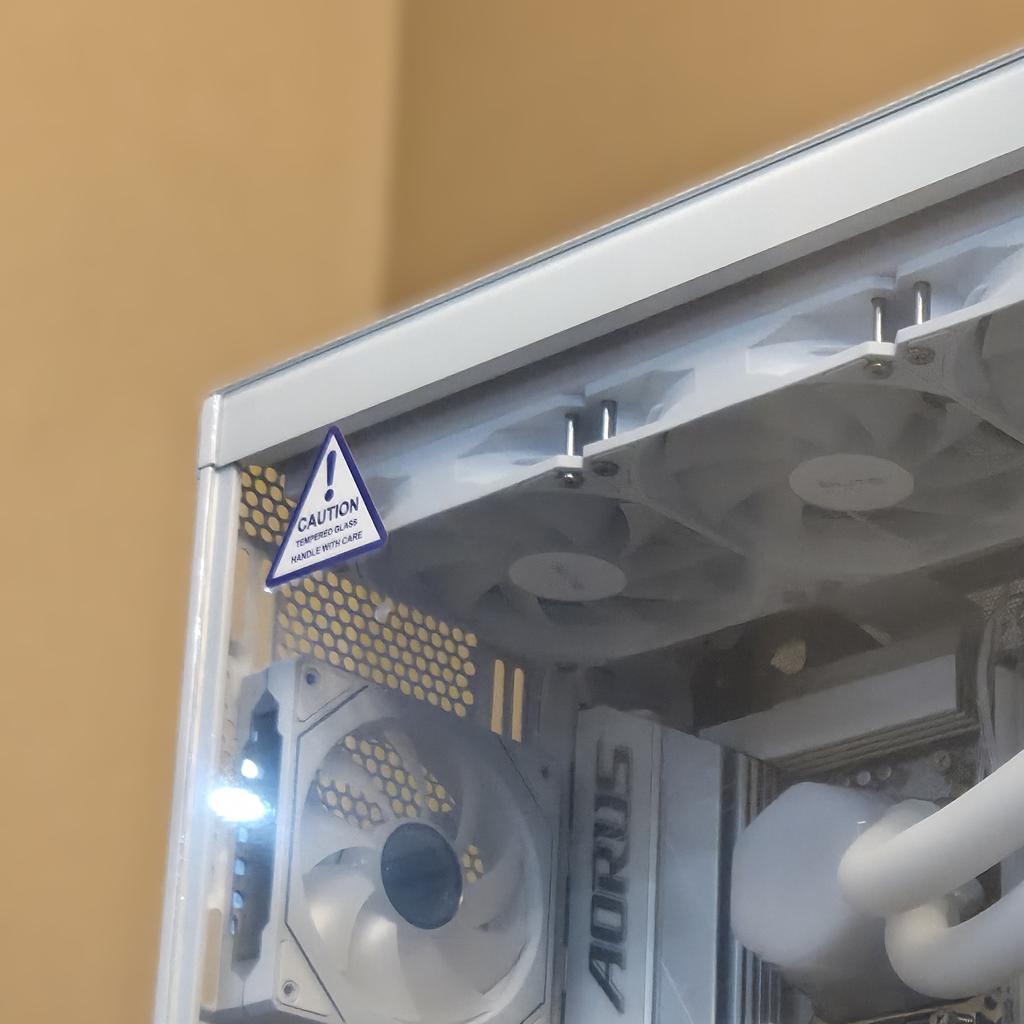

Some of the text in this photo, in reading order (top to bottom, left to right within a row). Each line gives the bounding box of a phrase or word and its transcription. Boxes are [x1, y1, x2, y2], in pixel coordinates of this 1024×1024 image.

[297, 496, 360, 533] CAUTION
[290, 530, 363, 565] HANDLE WITH CARE
[295, 518, 358, 548] TEMPERED GLASS
[589, 738, 632, 1015] AORUS
